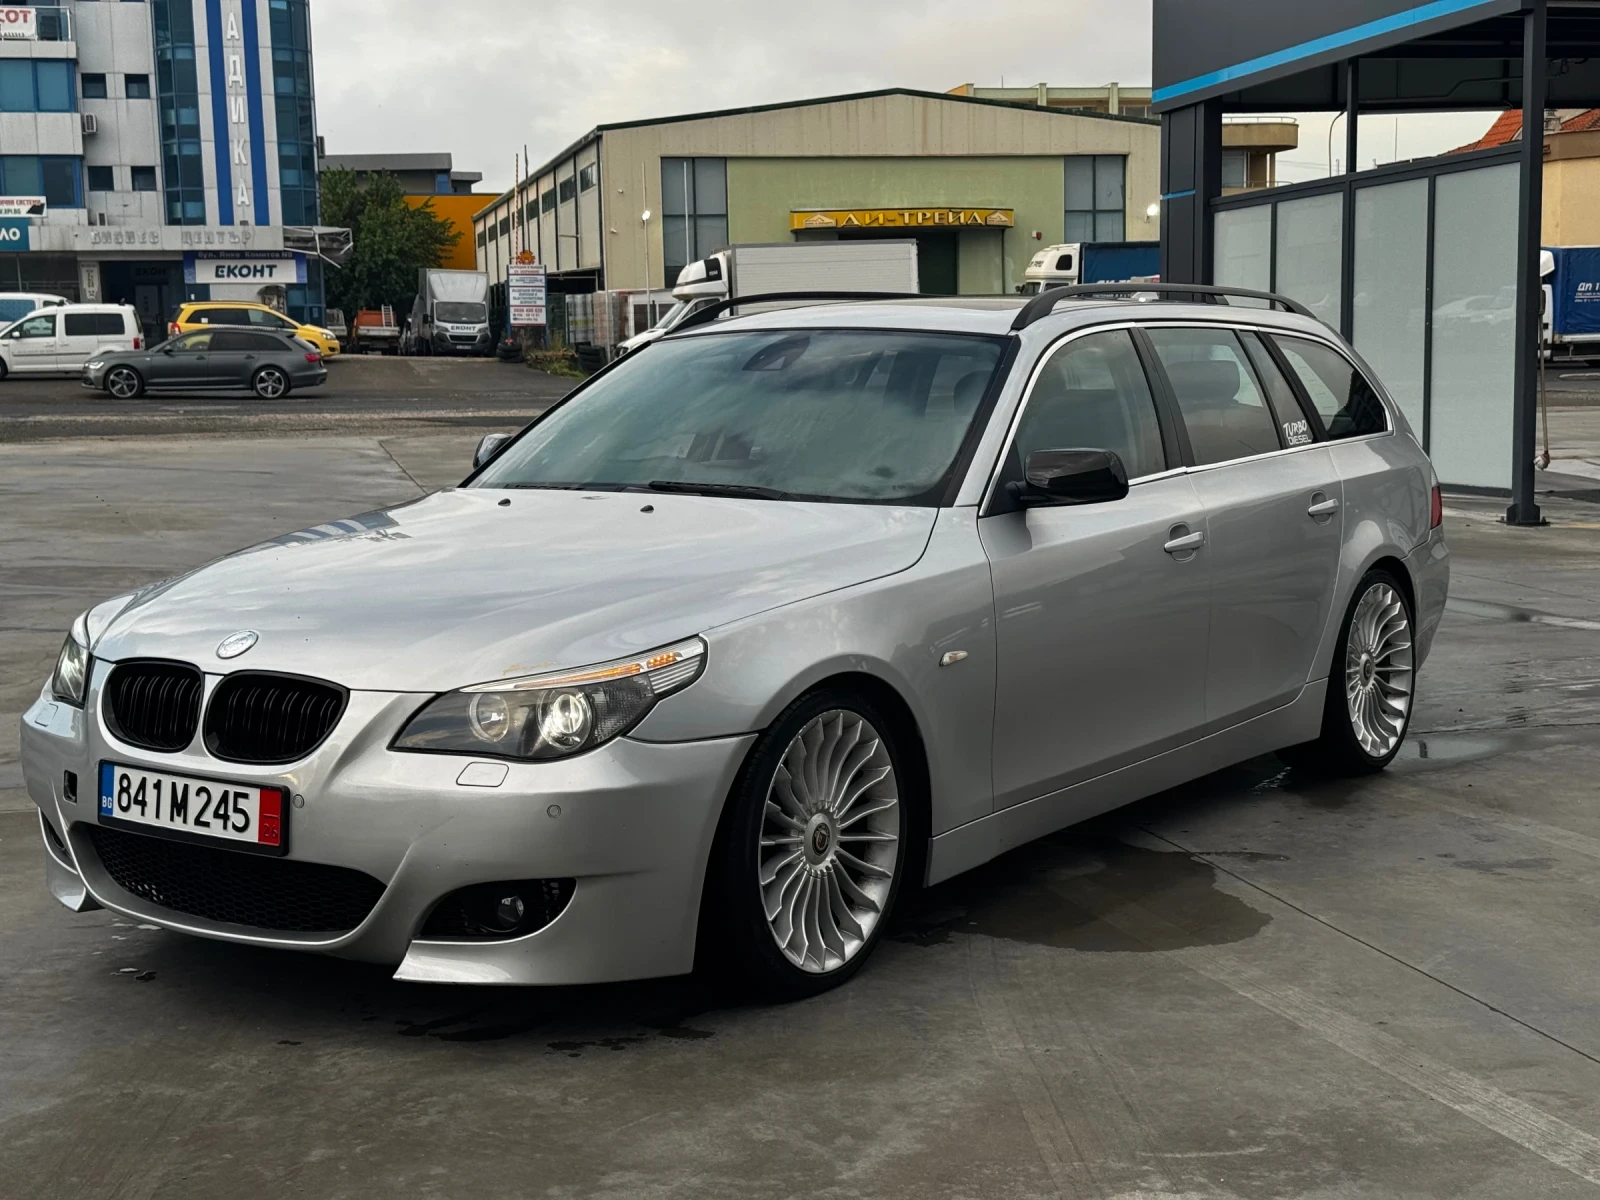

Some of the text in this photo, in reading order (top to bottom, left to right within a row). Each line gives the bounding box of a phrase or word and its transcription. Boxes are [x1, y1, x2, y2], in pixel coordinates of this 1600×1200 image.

[226, 11, 250, 207] АДИКА
[841, 209, 984, 227] ДИ-ТРЕЙД
[215, 264, 277, 279] ЕКОНТ
[1283, 420, 1307, 438] TURBO
[1288, 434, 1312, 446] DIESEL
[102, 795, 112, 809] BG
